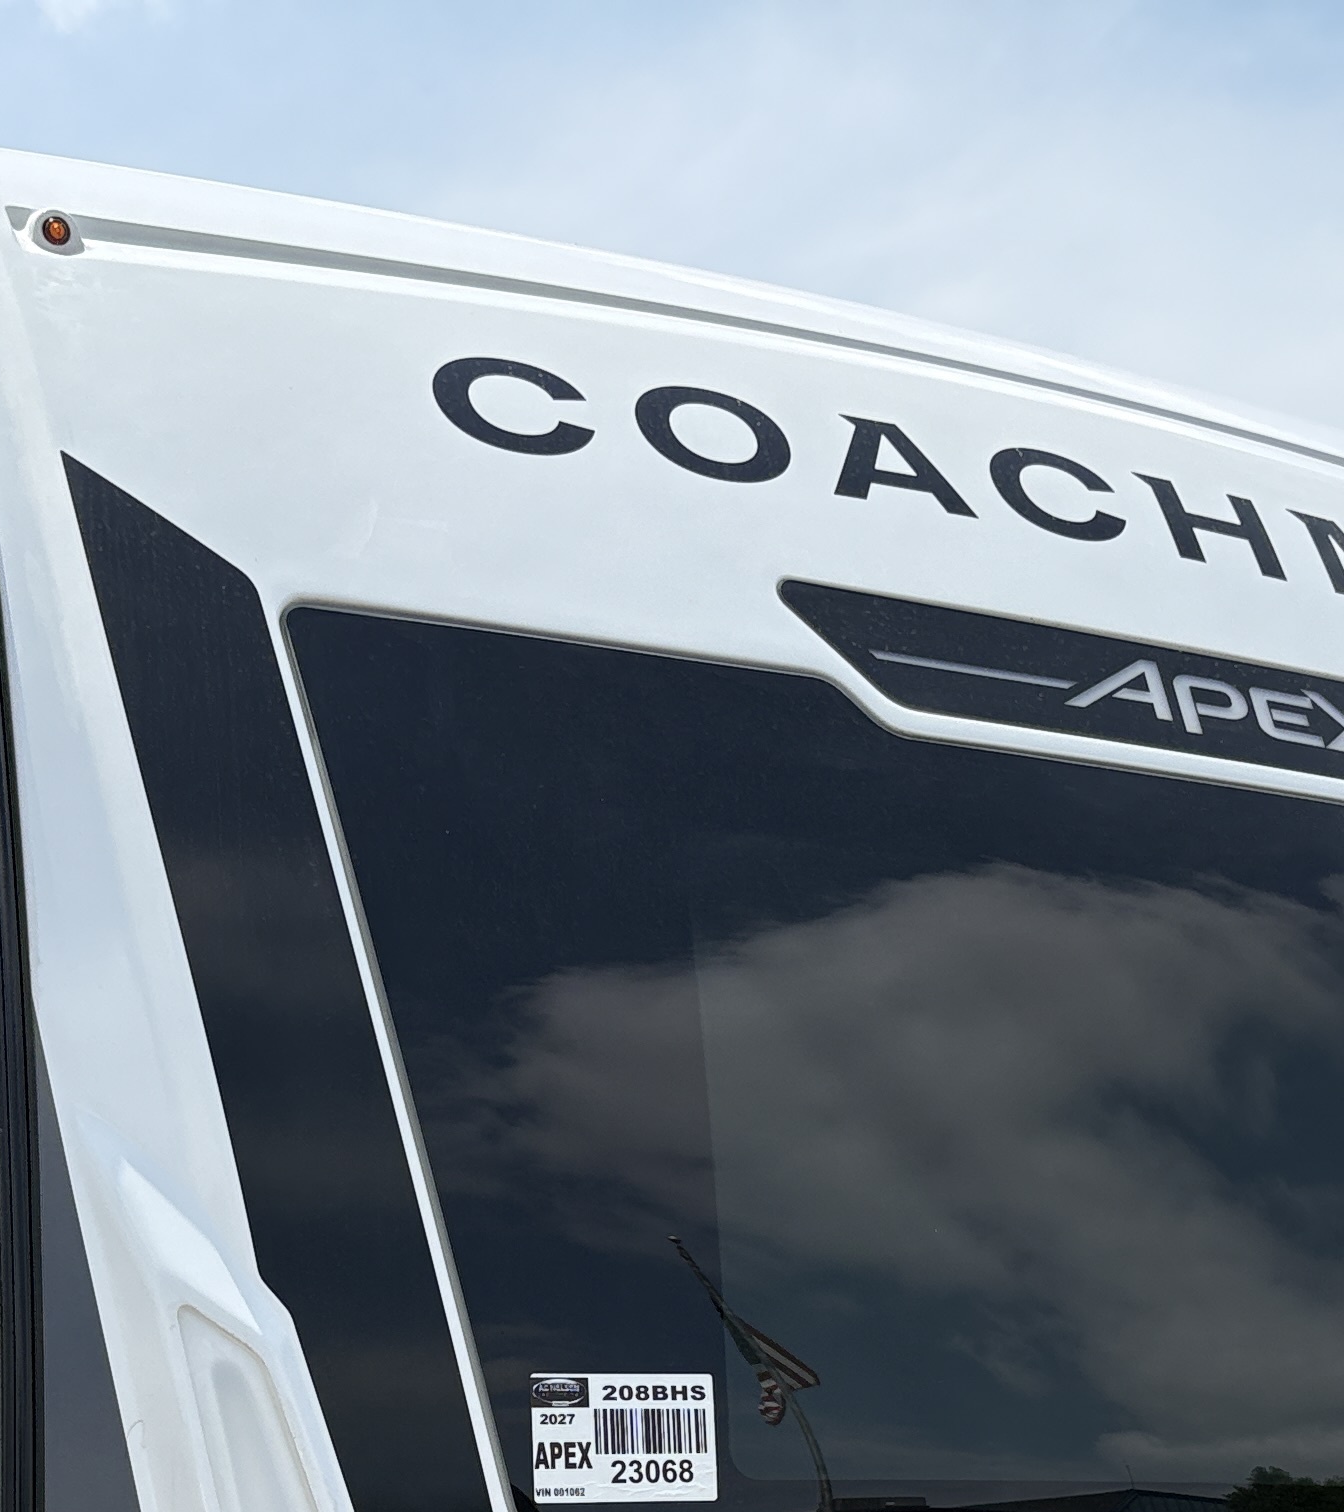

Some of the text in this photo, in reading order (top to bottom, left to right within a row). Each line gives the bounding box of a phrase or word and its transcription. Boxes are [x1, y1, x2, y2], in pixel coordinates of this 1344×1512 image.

[602, 1385, 706, 1401] 208BHS
[540, 1414, 575, 1425] 2027
[534, 1442, 593, 1469] APEX
[611, 1459, 694, 1483] 23068
[536, 1488, 551, 1497] VIN
